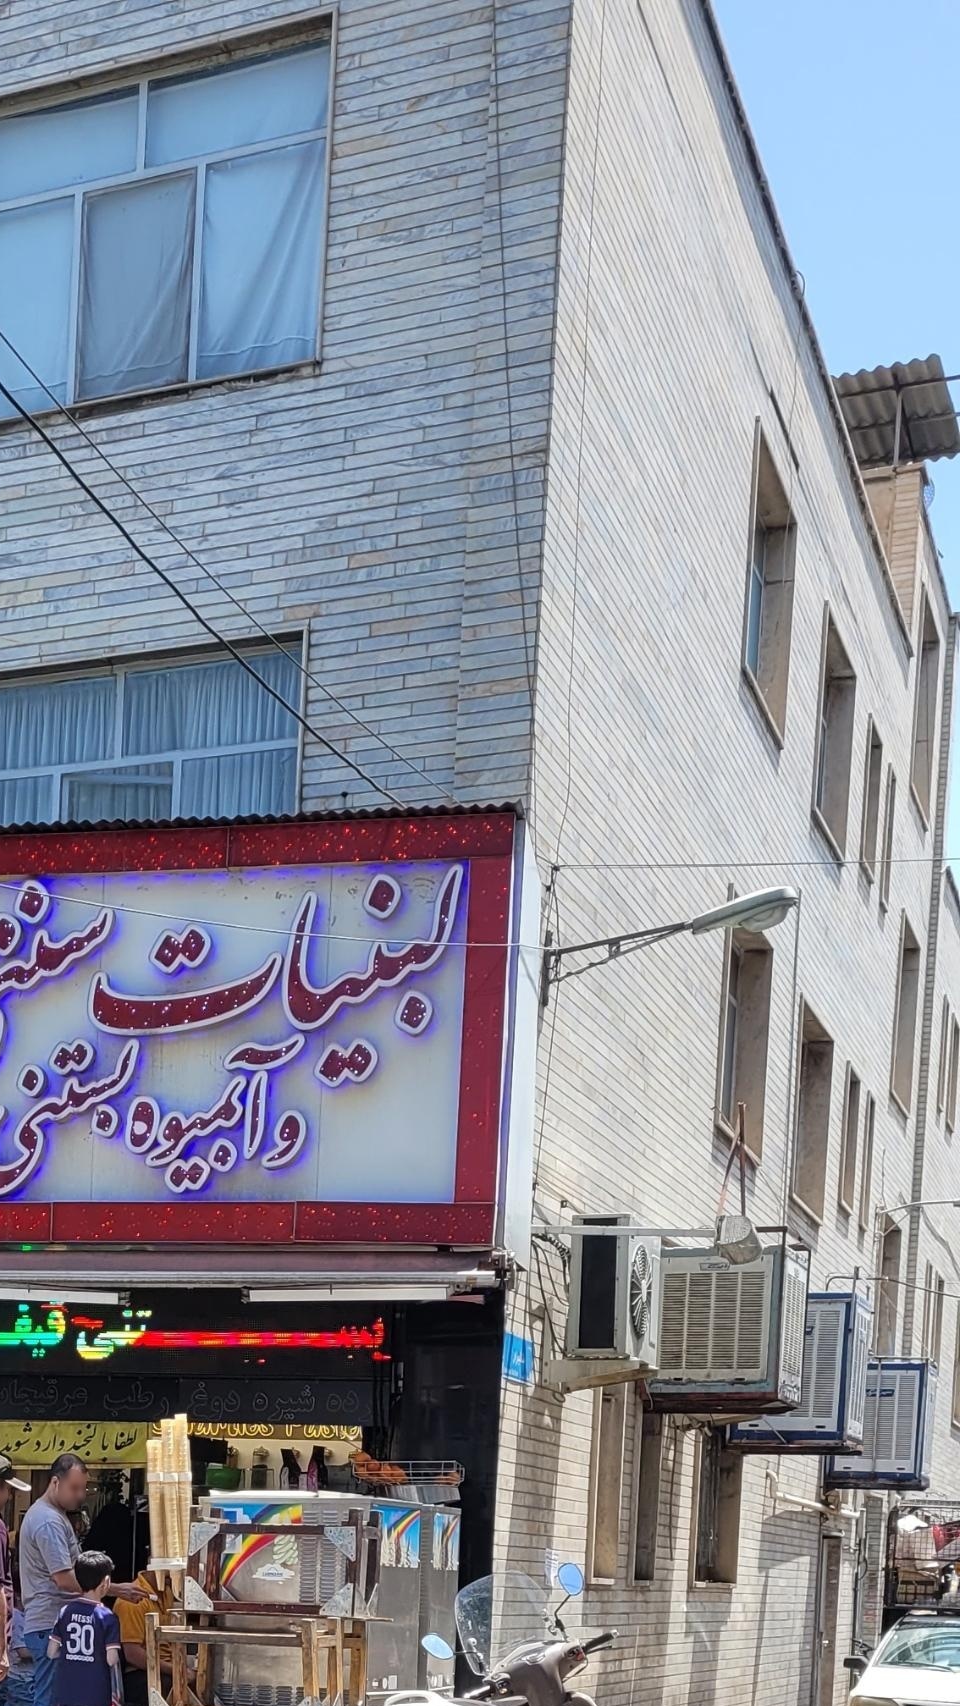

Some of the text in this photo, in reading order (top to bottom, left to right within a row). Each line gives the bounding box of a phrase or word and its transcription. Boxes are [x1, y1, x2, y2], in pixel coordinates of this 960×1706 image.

[89, 863, 465, 1087] لبنیات
[187, 1380, 241, 1422] دوغ
[252, 1383, 316, 1422] شیره
[0, 1422, 32, 1453] شوید
[33, 1434, 65, 1453] وارد
[71, 1423, 97, 1456] لبخند
[101, 1431, 109, 1462] با
[114, 1427, 137, 1451] لطفا
[71, 1613, 93, 1624] MESSI
[66, 1622, 95, 1655] 30
